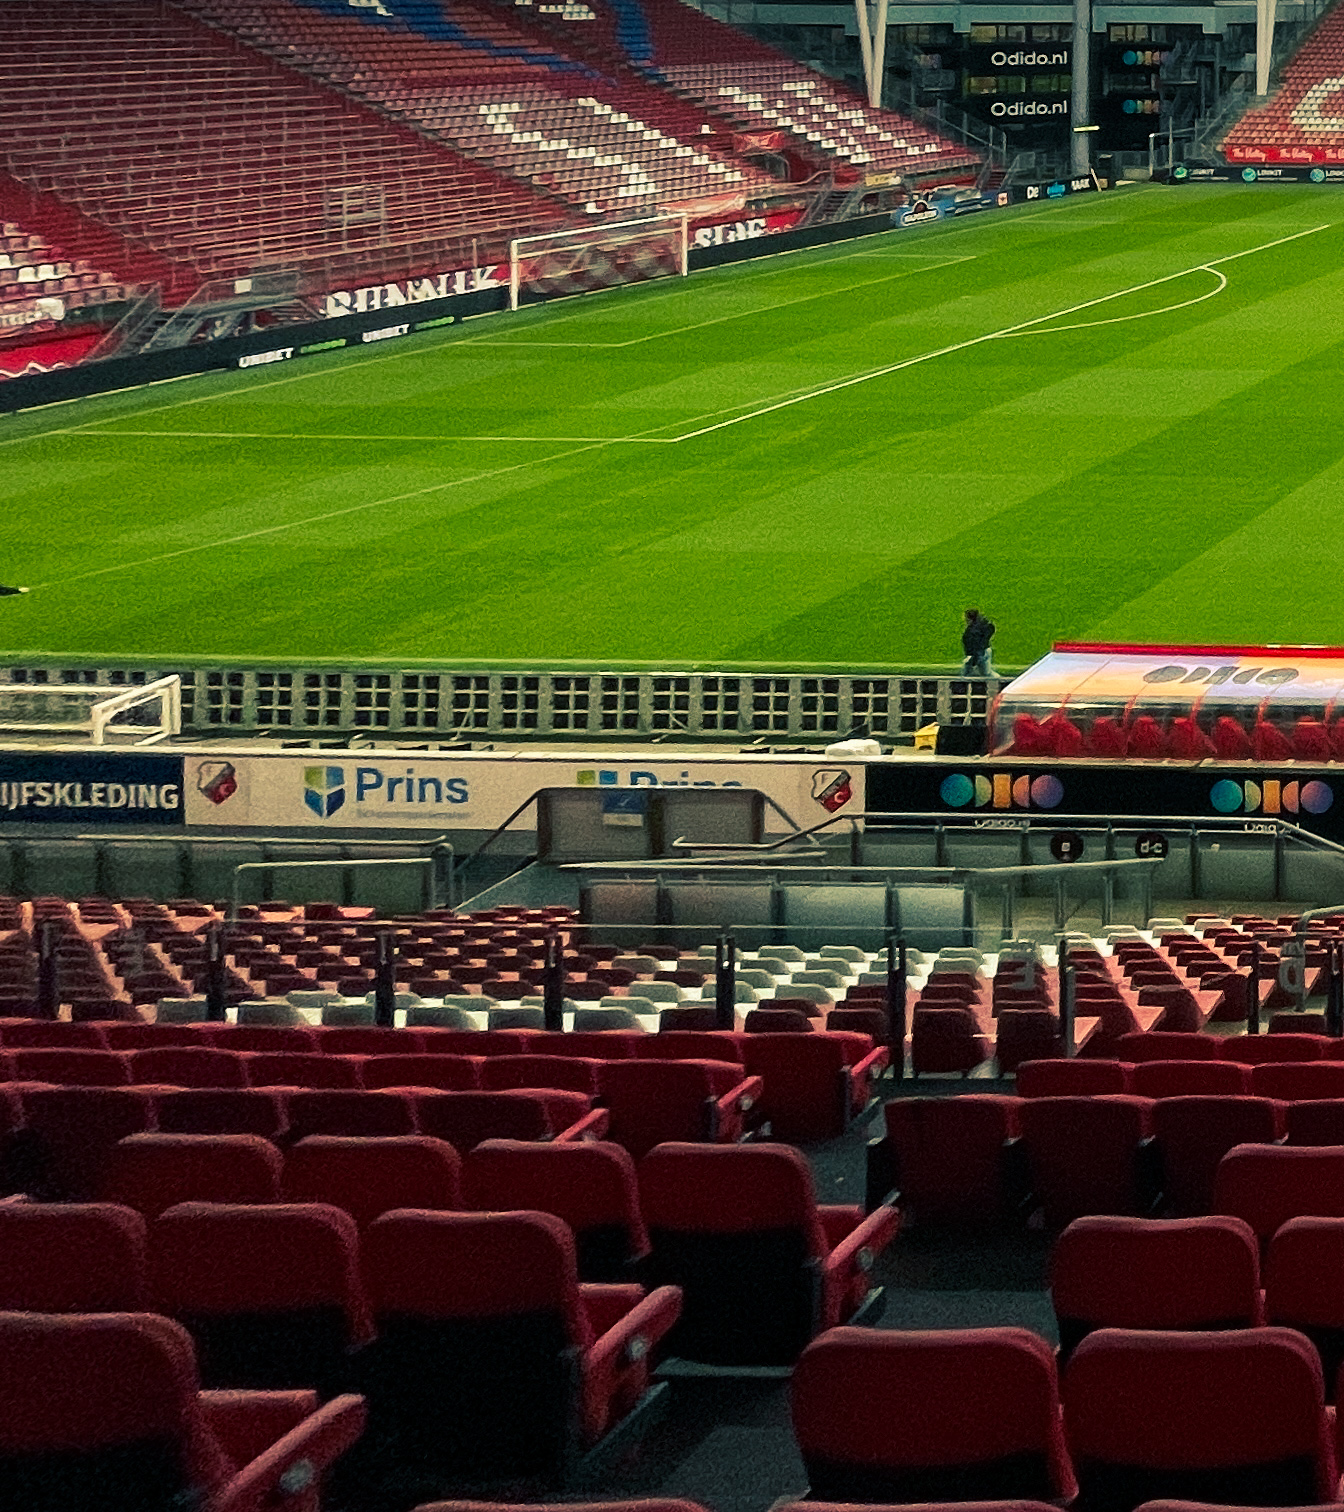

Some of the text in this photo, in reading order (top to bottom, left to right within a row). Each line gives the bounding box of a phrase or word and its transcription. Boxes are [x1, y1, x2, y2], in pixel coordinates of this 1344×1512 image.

[990, 50, 1069, 66] Odido.nl
[990, 99, 1069, 117] Odido.nl
[356, 767, 470, 804] Prins
